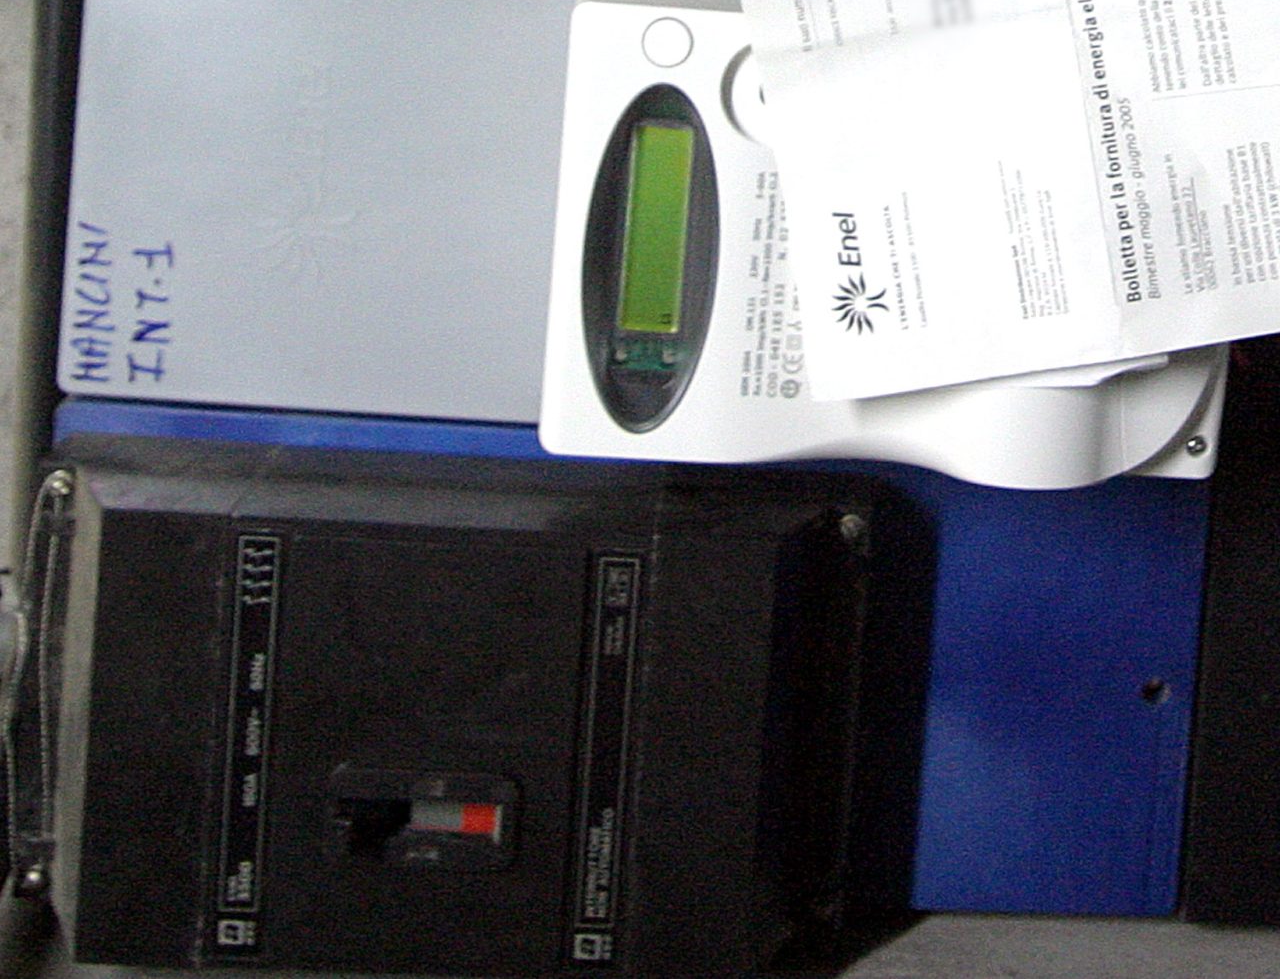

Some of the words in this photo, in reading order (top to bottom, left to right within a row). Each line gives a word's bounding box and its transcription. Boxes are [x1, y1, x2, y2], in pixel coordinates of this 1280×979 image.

[1079, 17, 1109, 81] energia
[1090, 84, 1109, 102] di
[1116, 97, 1134, 131] 2005
[1093, 104, 1122, 180] fornitura
[1122, 133, 1145, 181] giugno
[1107, 183, 1125, 200] la
[1132, 190, 1155, 241] maggio
[830, 210, 863, 271] Enel
[1115, 203, 1135, 232] per
[1115, 235, 1143, 304] Bolletta
[1140, 242, 1162, 301] Bimestre
